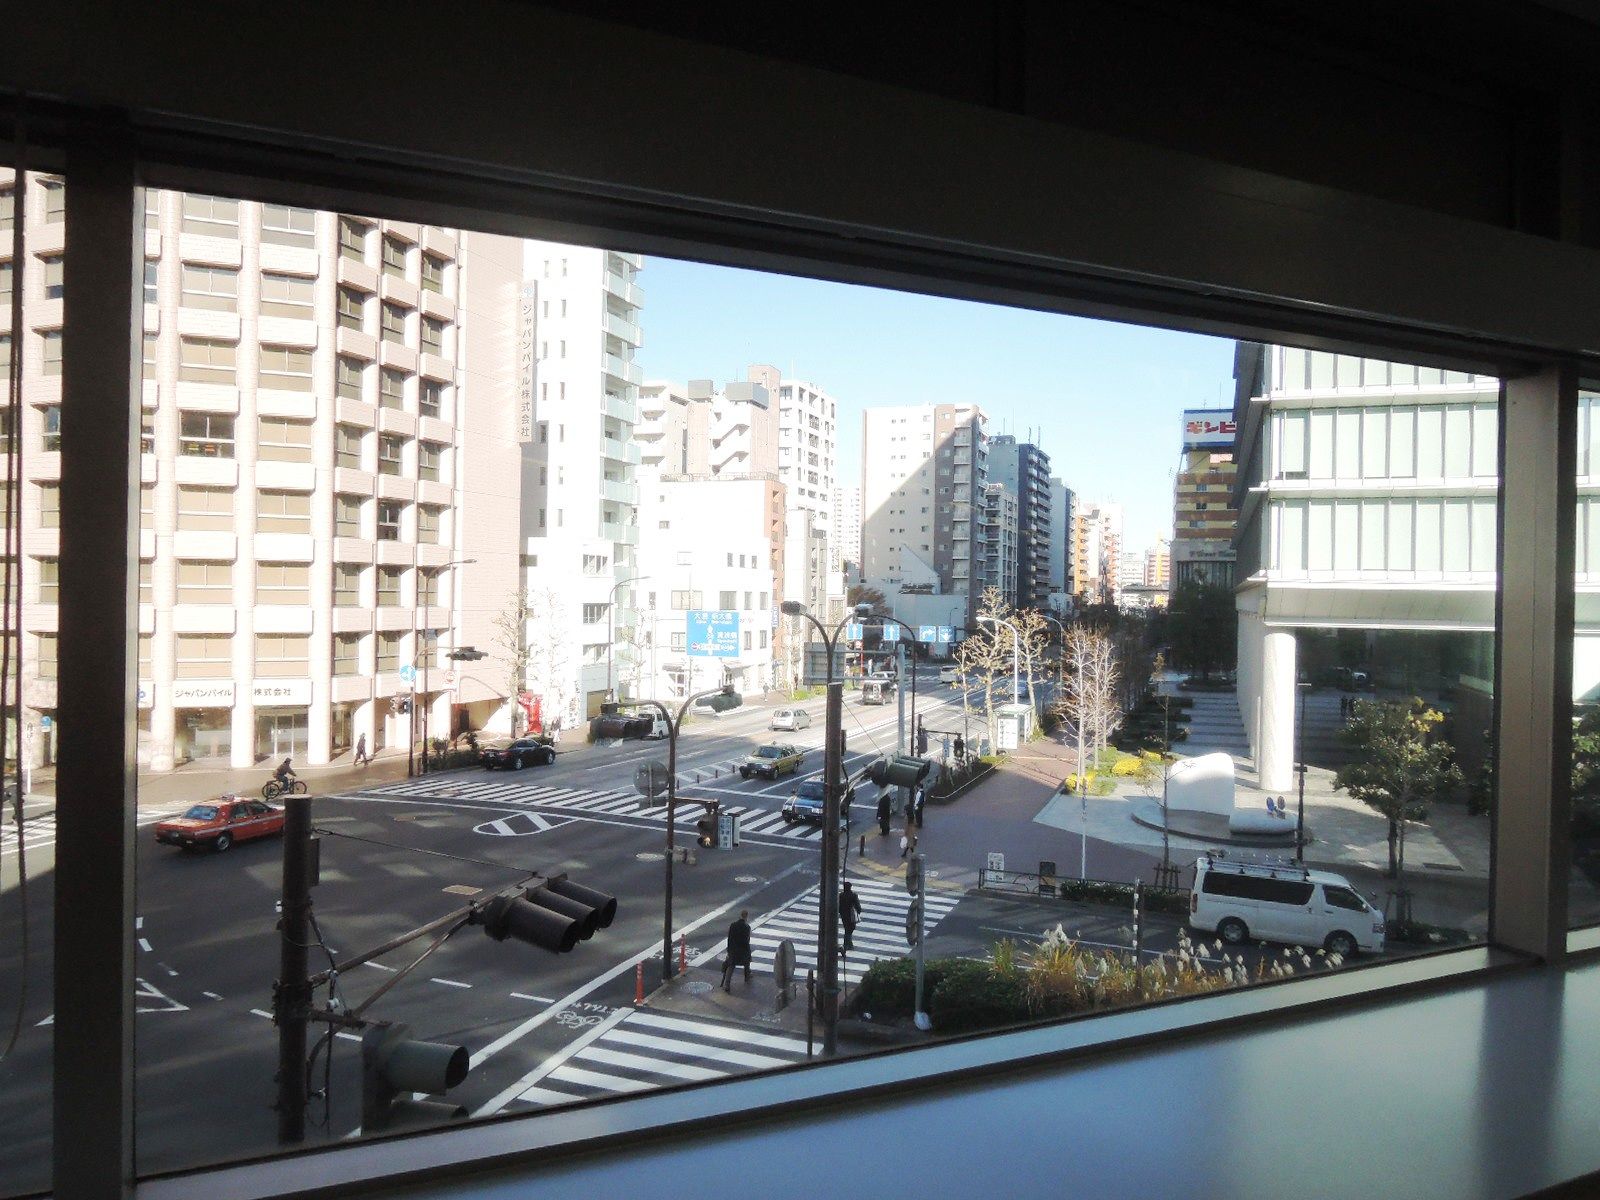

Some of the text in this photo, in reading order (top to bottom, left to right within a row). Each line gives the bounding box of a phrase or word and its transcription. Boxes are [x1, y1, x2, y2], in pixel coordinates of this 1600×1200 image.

[175, 688, 291, 698] ジャパンパイル 株式会社
